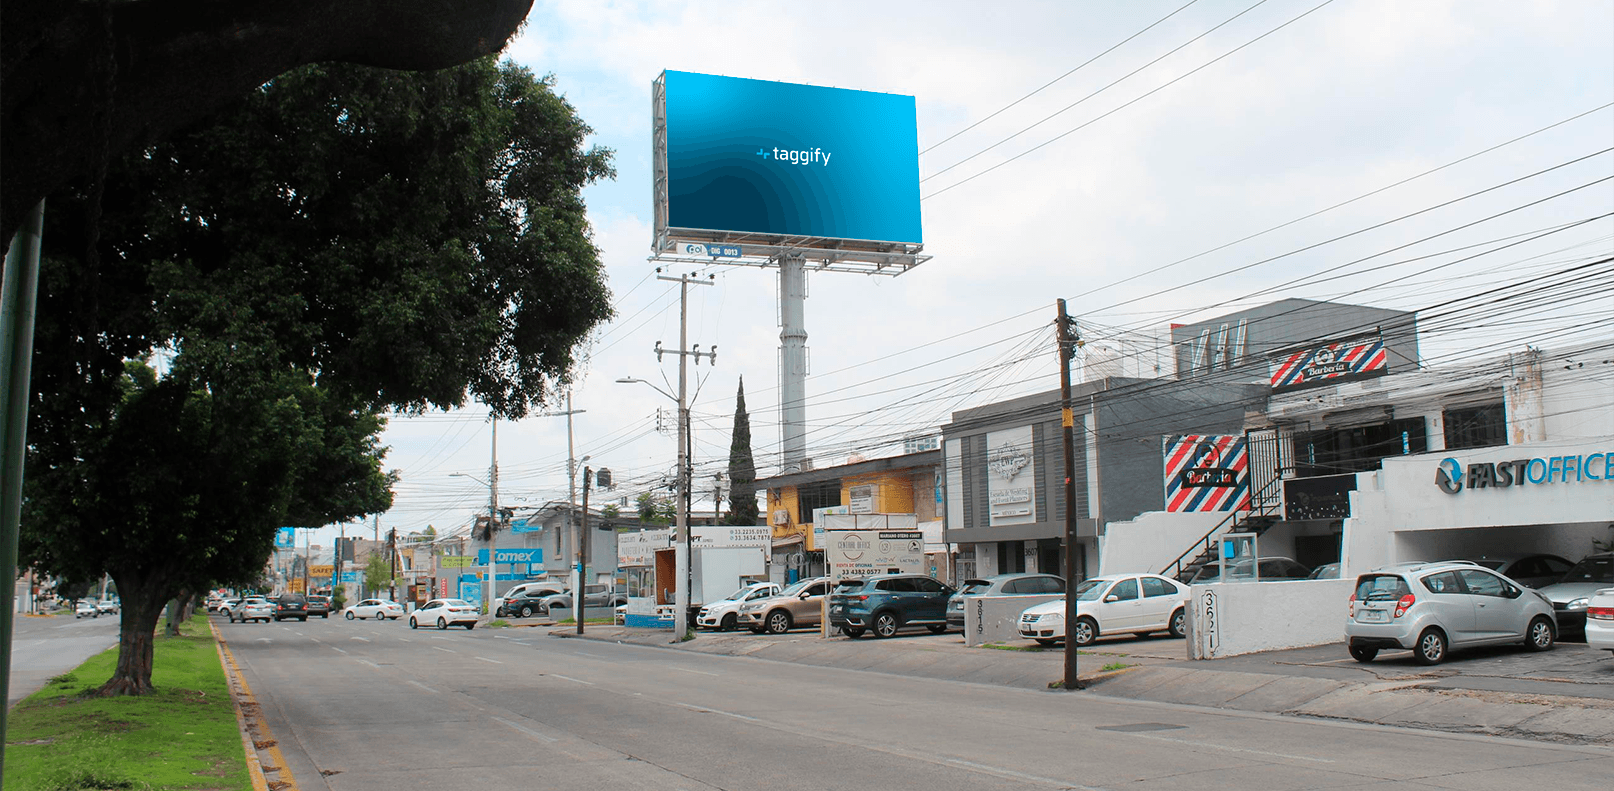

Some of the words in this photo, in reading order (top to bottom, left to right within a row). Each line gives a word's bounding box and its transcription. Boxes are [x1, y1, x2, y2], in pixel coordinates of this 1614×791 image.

[772, 146, 832, 167] taggify
[724, 248, 738, 256] 0013
[1024, 548, 1038, 557] 3607
